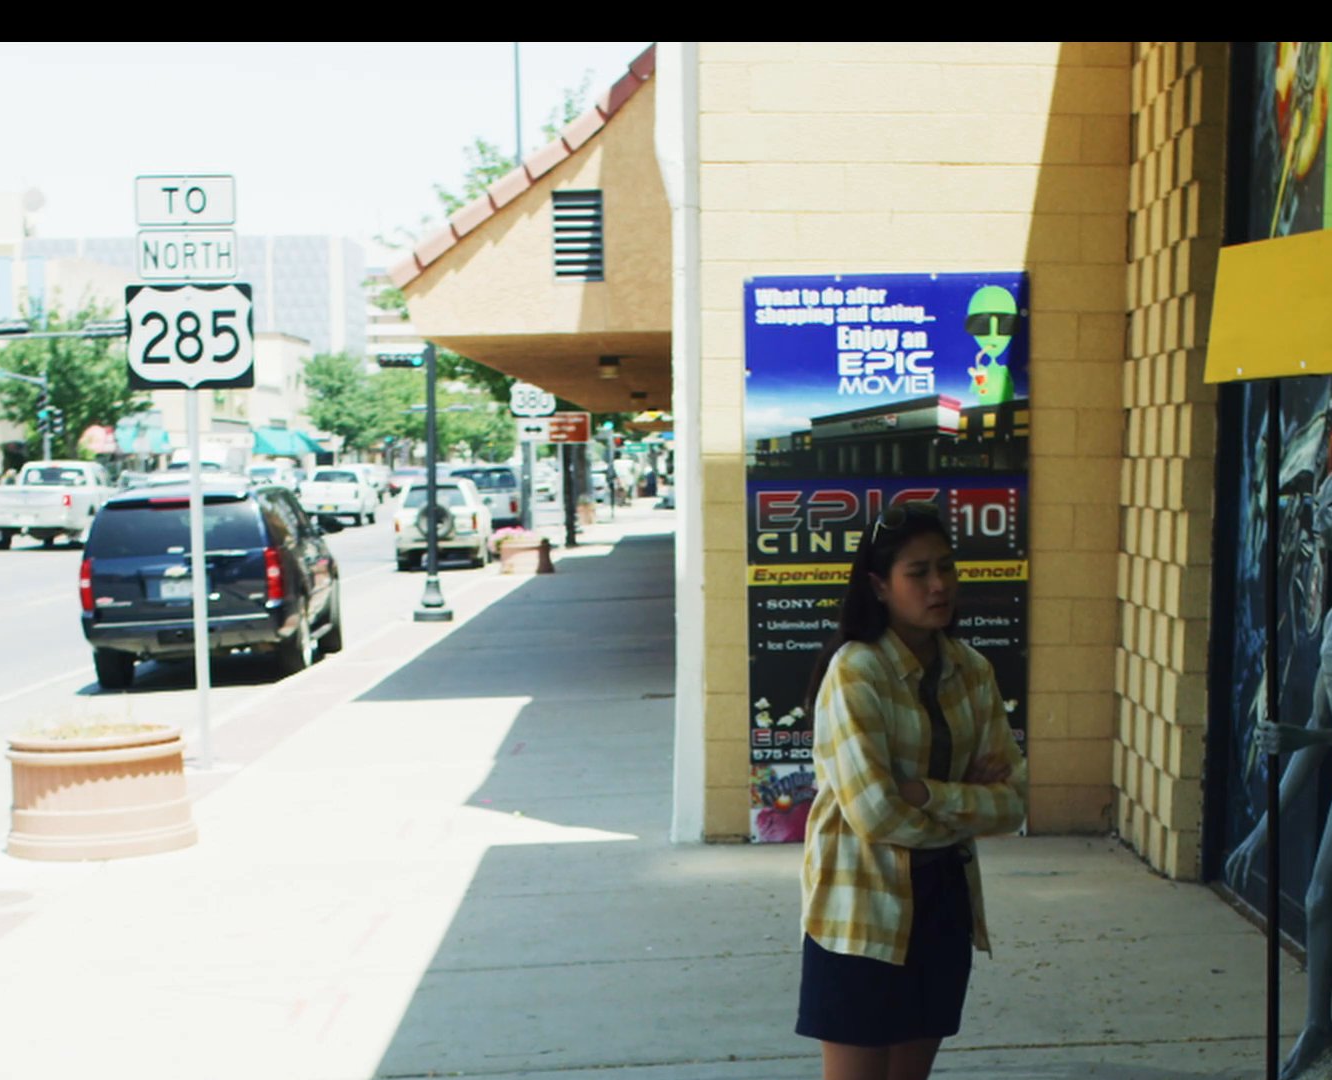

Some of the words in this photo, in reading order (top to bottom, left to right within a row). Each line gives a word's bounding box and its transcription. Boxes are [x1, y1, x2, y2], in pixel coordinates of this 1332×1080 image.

[162, 187, 207, 214] TO
[143, 241, 232, 270] NORTH
[755, 288, 800, 306] What
[802, 288, 819, 304] to
[821, 287, 844, 304] do
[845, 286, 887, 305] after
[755, 306, 834, 325] shopping
[836, 306, 868, 322] and
[141, 311, 240, 364] 285
[837, 326, 899, 351] Enjoy
[901, 331, 927, 349] an
[838, 351, 935, 375] EPIC
[837, 375, 935, 395] MOVIE!
[960, 503, 1007, 537] 10
[757, 531, 864, 553] CINE
[753, 568, 853, 585] Experienc
[957, 559, 1023, 579] rence!
[766, 598, 815, 609] SONY
[767, 619, 818, 631] Unlimited
[975, 615, 1010, 628] Drinks
[767, 639, 783, 650] Ice
[786, 640, 823, 651] Cream
[972, 635, 1010, 648] Games
